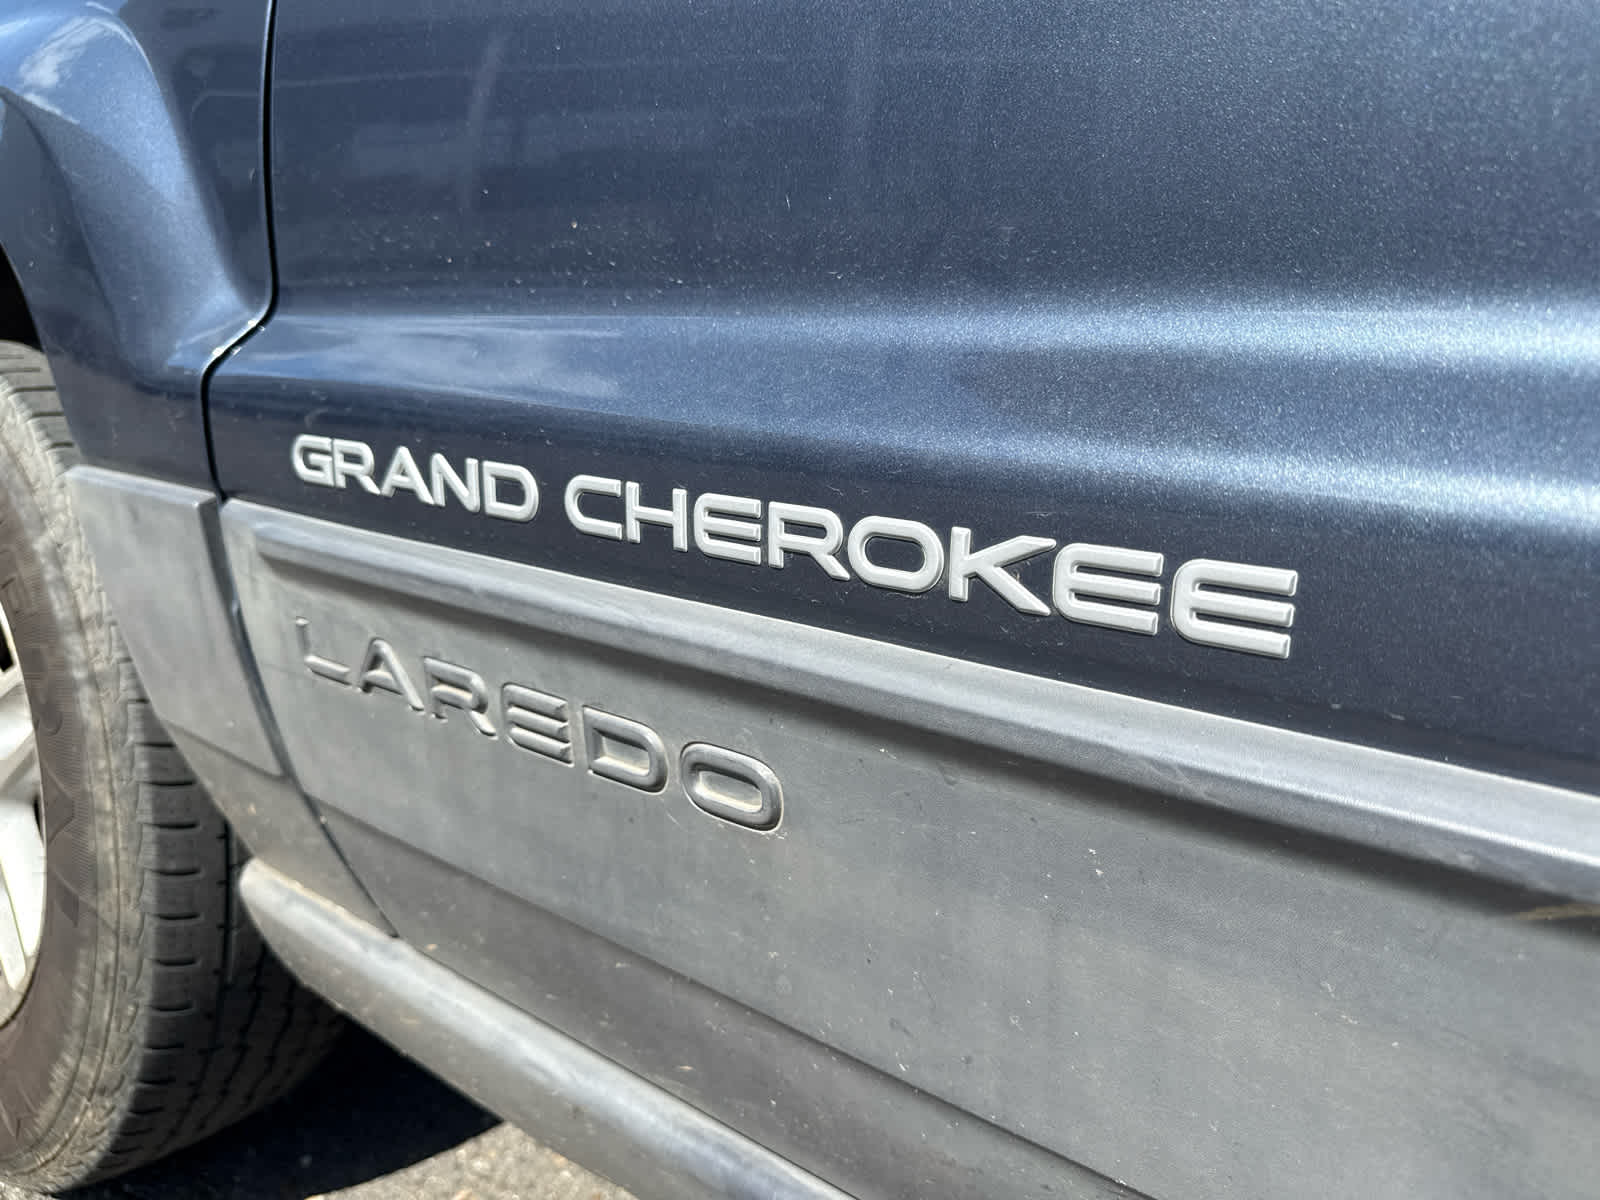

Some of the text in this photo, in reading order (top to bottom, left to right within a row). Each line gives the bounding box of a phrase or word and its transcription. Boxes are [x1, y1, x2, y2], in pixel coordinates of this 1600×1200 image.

[292, 433, 1299, 659] GRAND CHEROKEE
[296, 616, 784, 832] LAREDO
